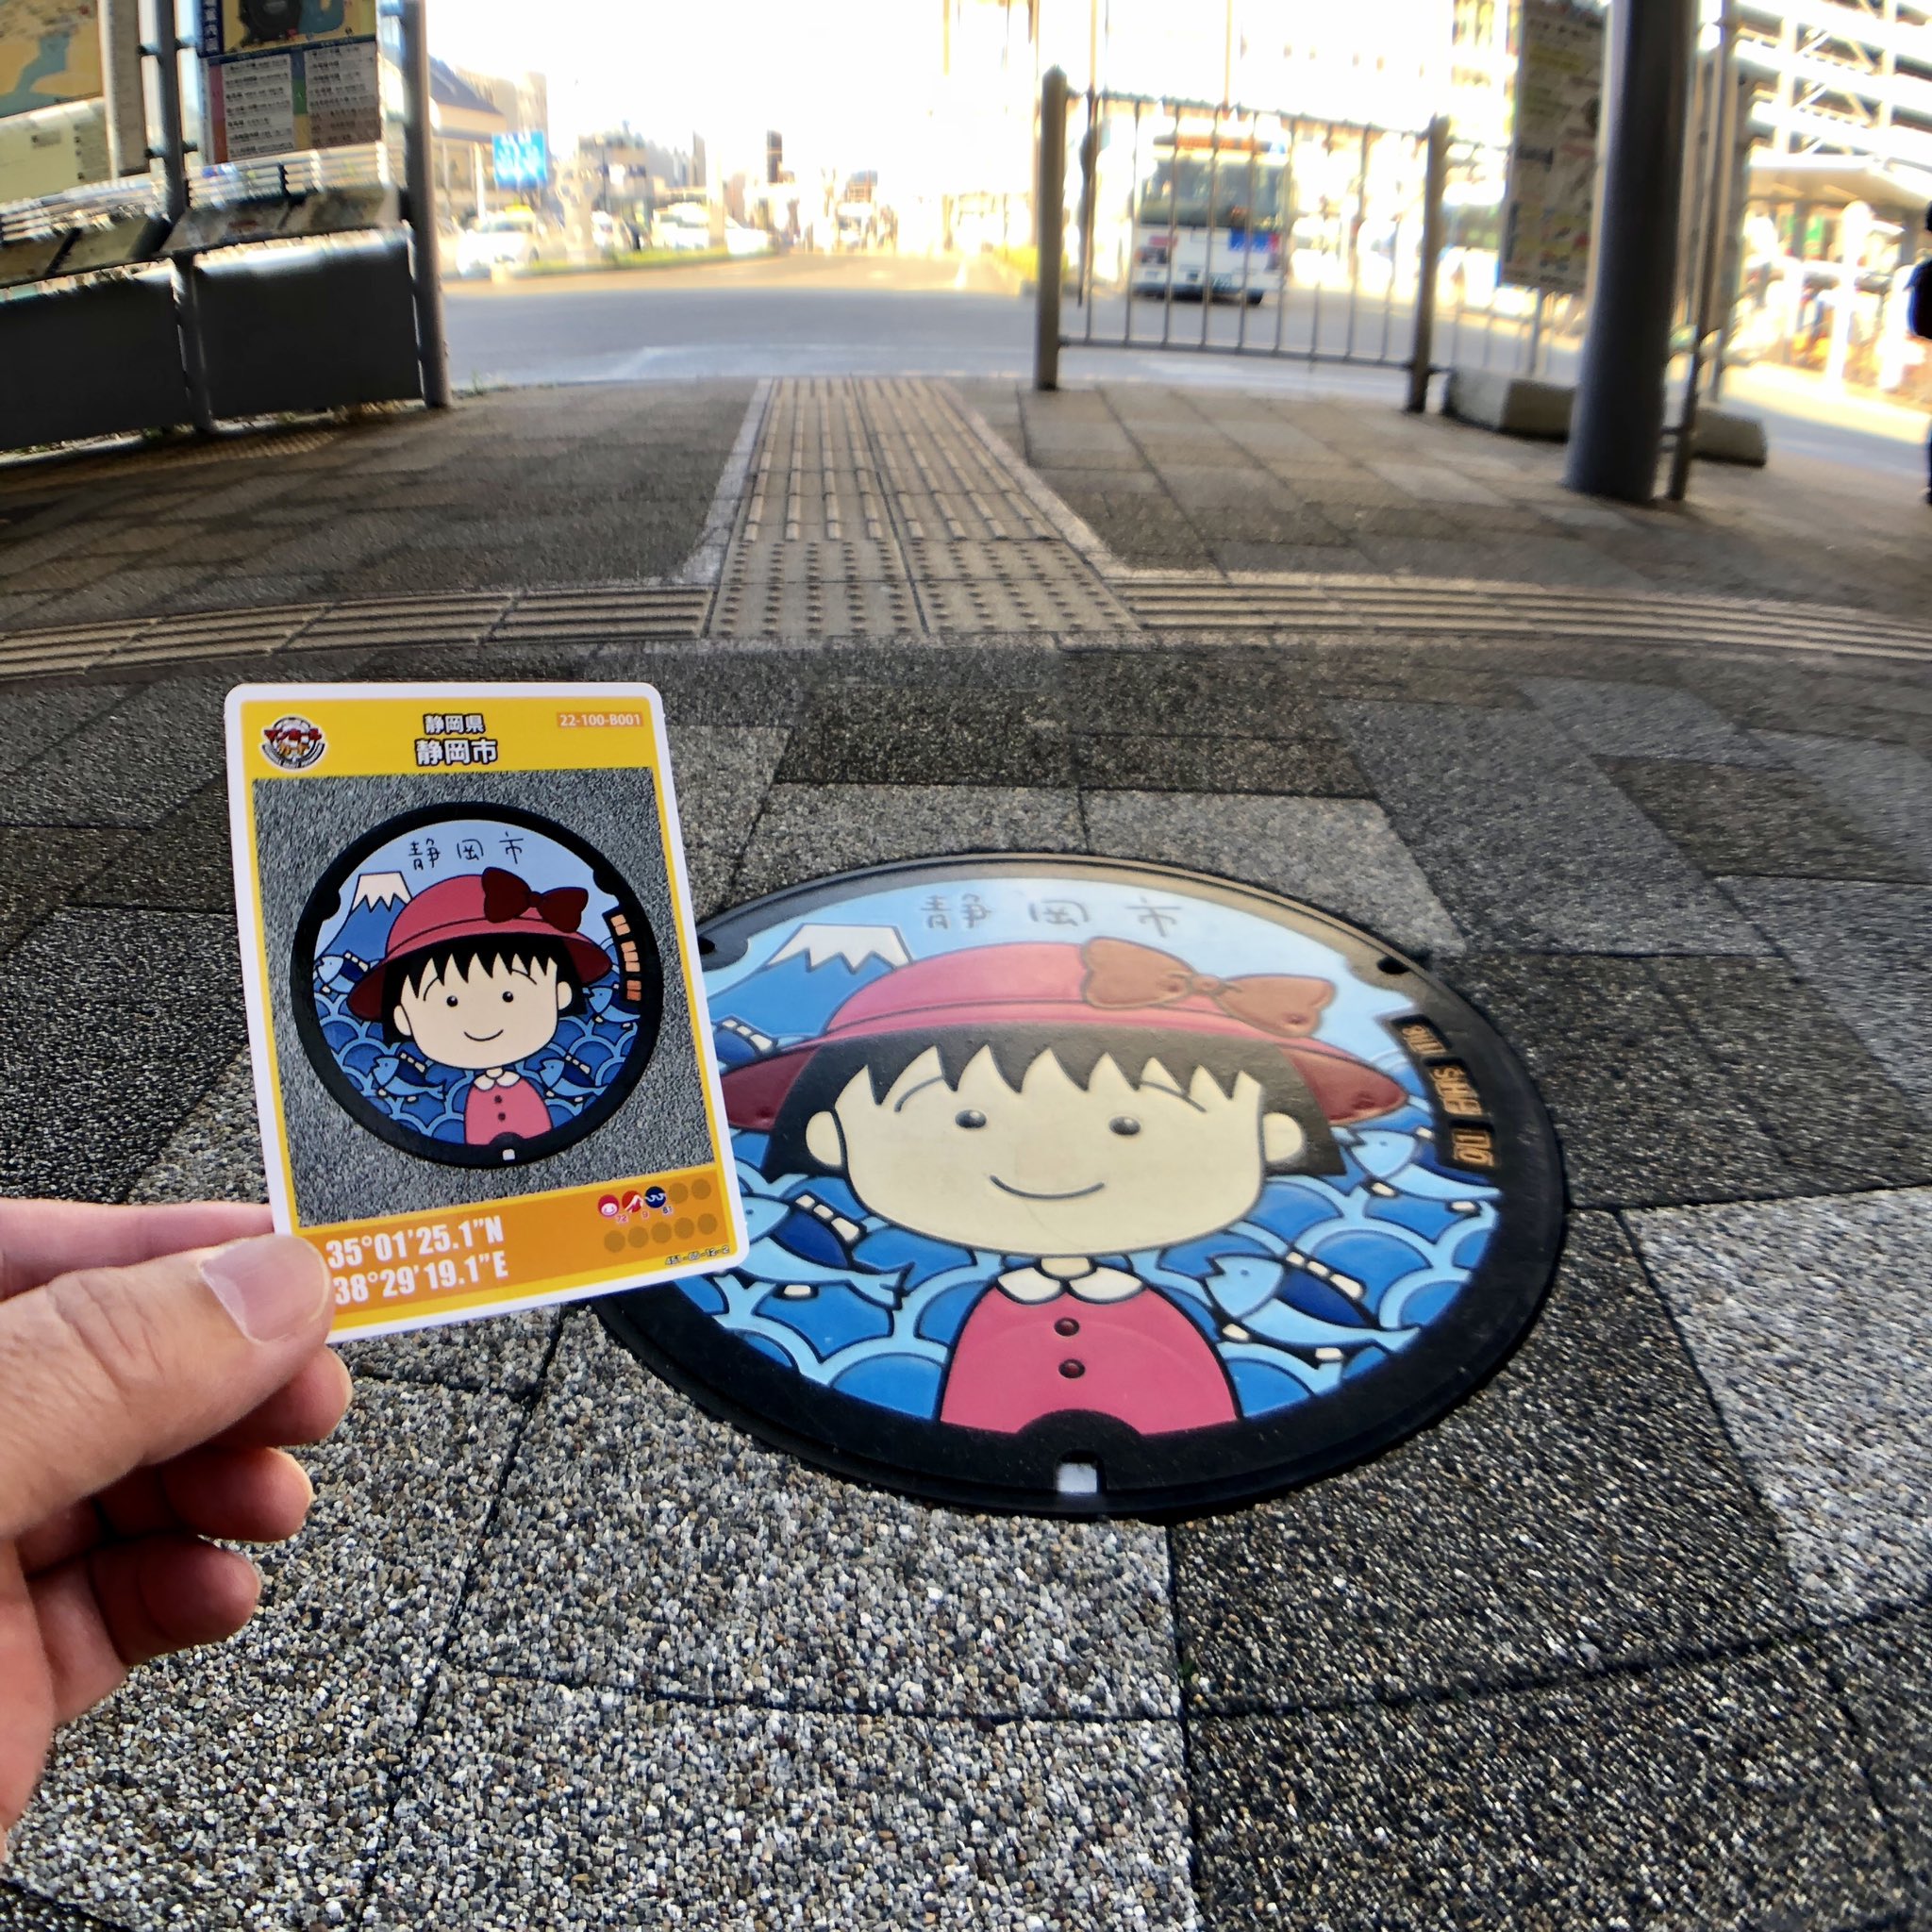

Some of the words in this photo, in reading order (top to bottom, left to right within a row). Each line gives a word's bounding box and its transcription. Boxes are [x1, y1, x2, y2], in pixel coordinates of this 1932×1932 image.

[423, 713, 486, 735] 静岡県
[559, 713, 641, 726] 22-100-B001
[414, 737, 498, 767] 静岡市
